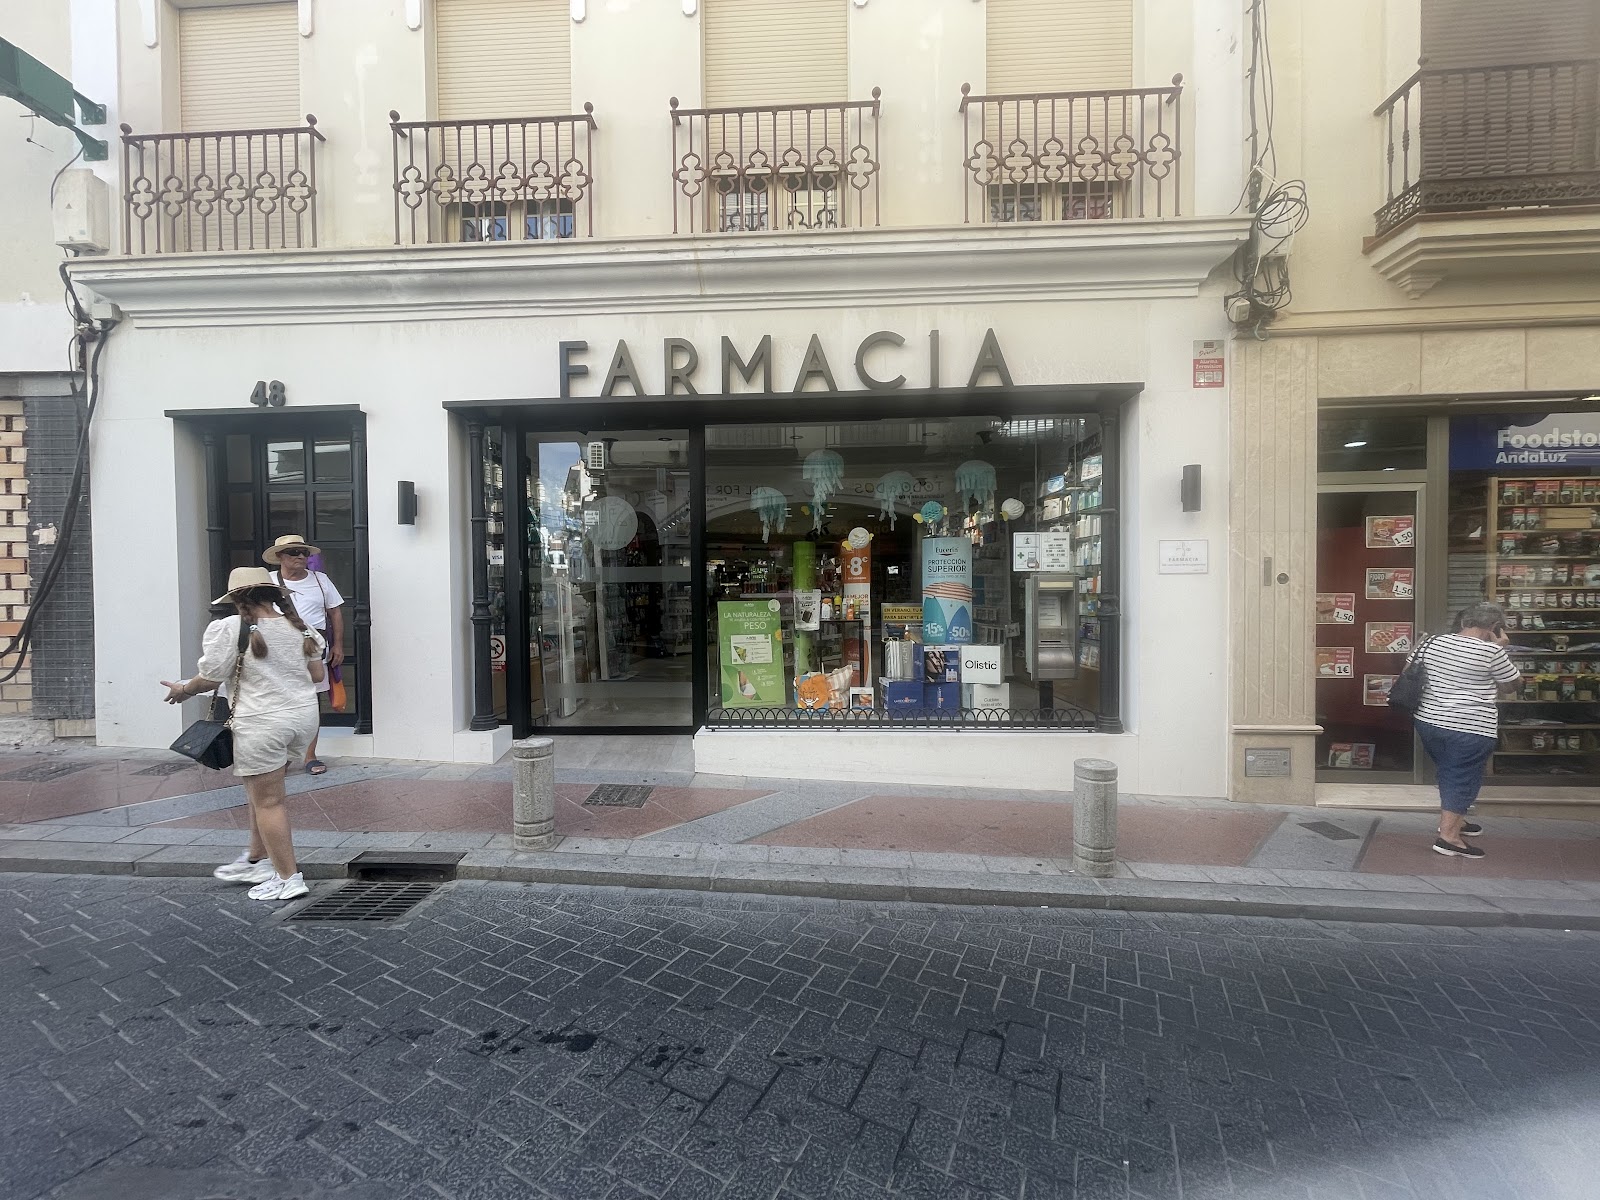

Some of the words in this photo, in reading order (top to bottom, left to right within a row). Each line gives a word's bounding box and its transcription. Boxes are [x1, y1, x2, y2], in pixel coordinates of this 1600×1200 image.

[559, 328, 1014, 398] FARMACIA
[250, 380, 286, 408] 48
[1497, 428, 1600, 448] Foodsto
[1394, 531, 1413, 545] 1.50
[1394, 585, 1413, 595] 1.50
[1335, 611, 1354, 621] 1.50
[744, 621, 767, 630] PESO
[1390, 638, 1408, 653] 1.50
[964, 659, 998, 670] Olistic
[1337, 665, 1350, 674] 1€
